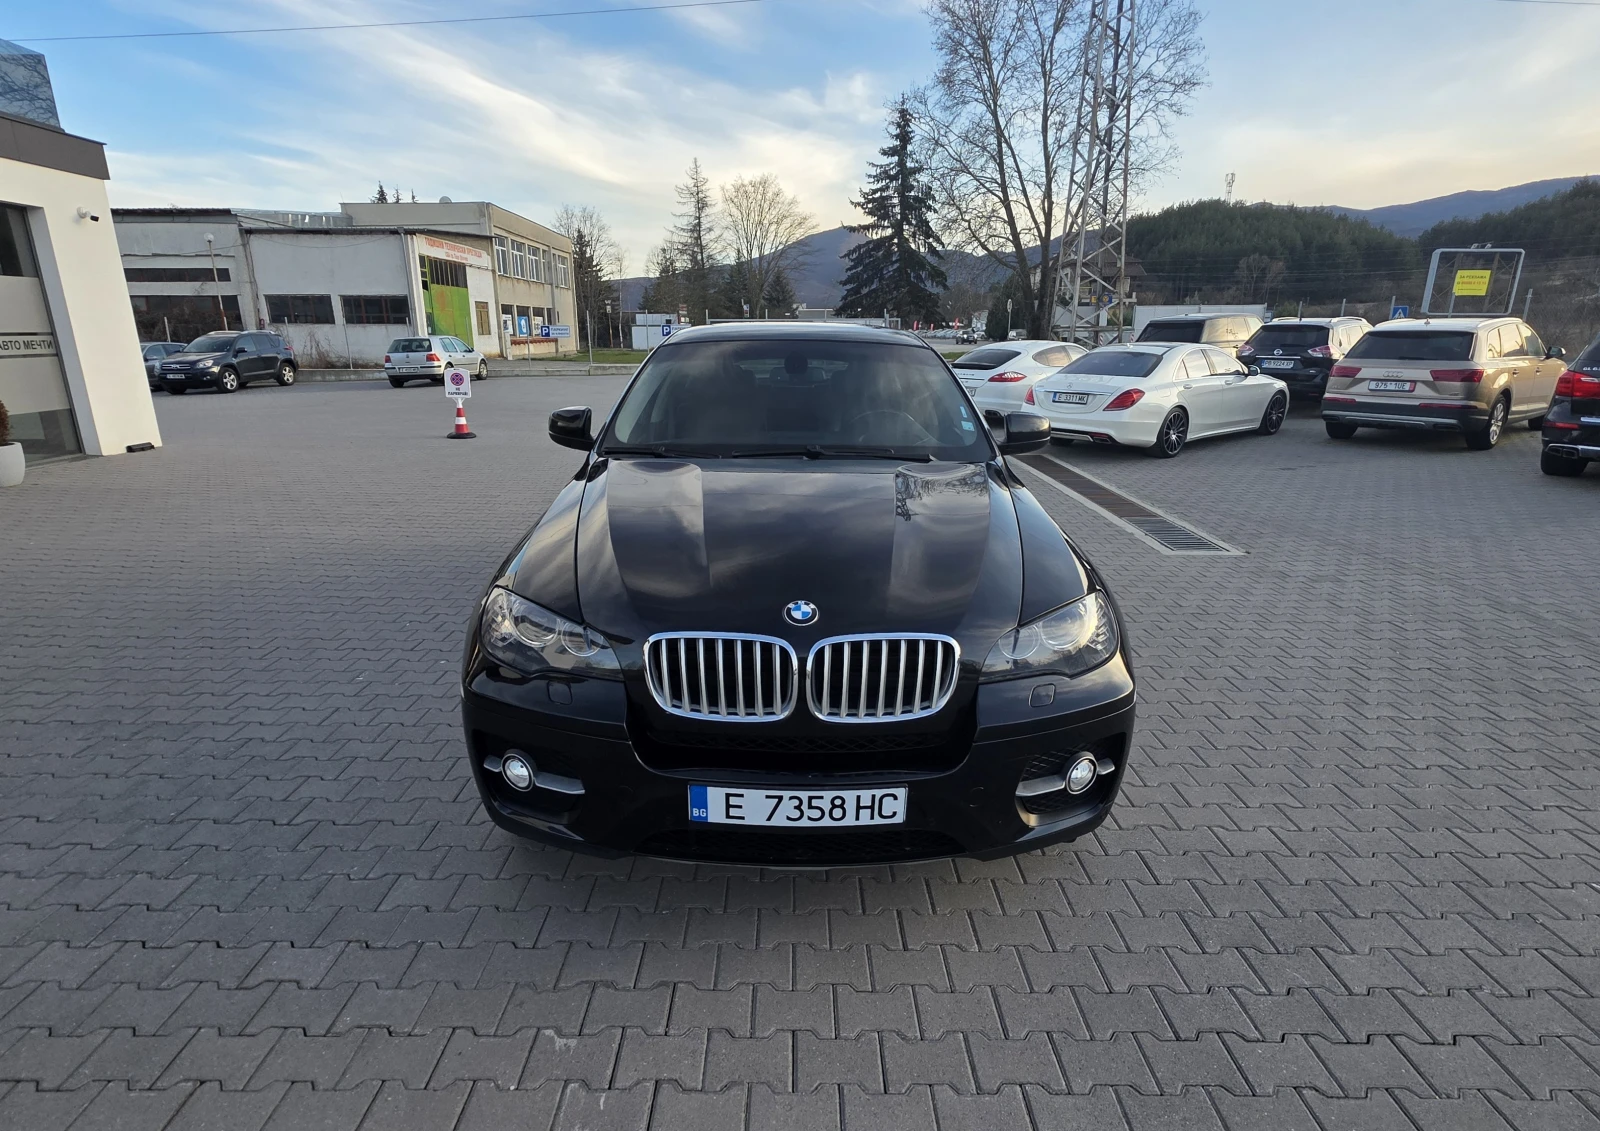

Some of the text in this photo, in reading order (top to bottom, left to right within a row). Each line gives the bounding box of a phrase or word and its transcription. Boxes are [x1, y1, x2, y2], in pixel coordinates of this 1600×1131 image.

[543, 327, 548, 335] P
[22, 340, 53, 350] МЕЧТИ
[724, 792, 899, 822] E 7358 HC
[692, 808, 707, 817] BG
